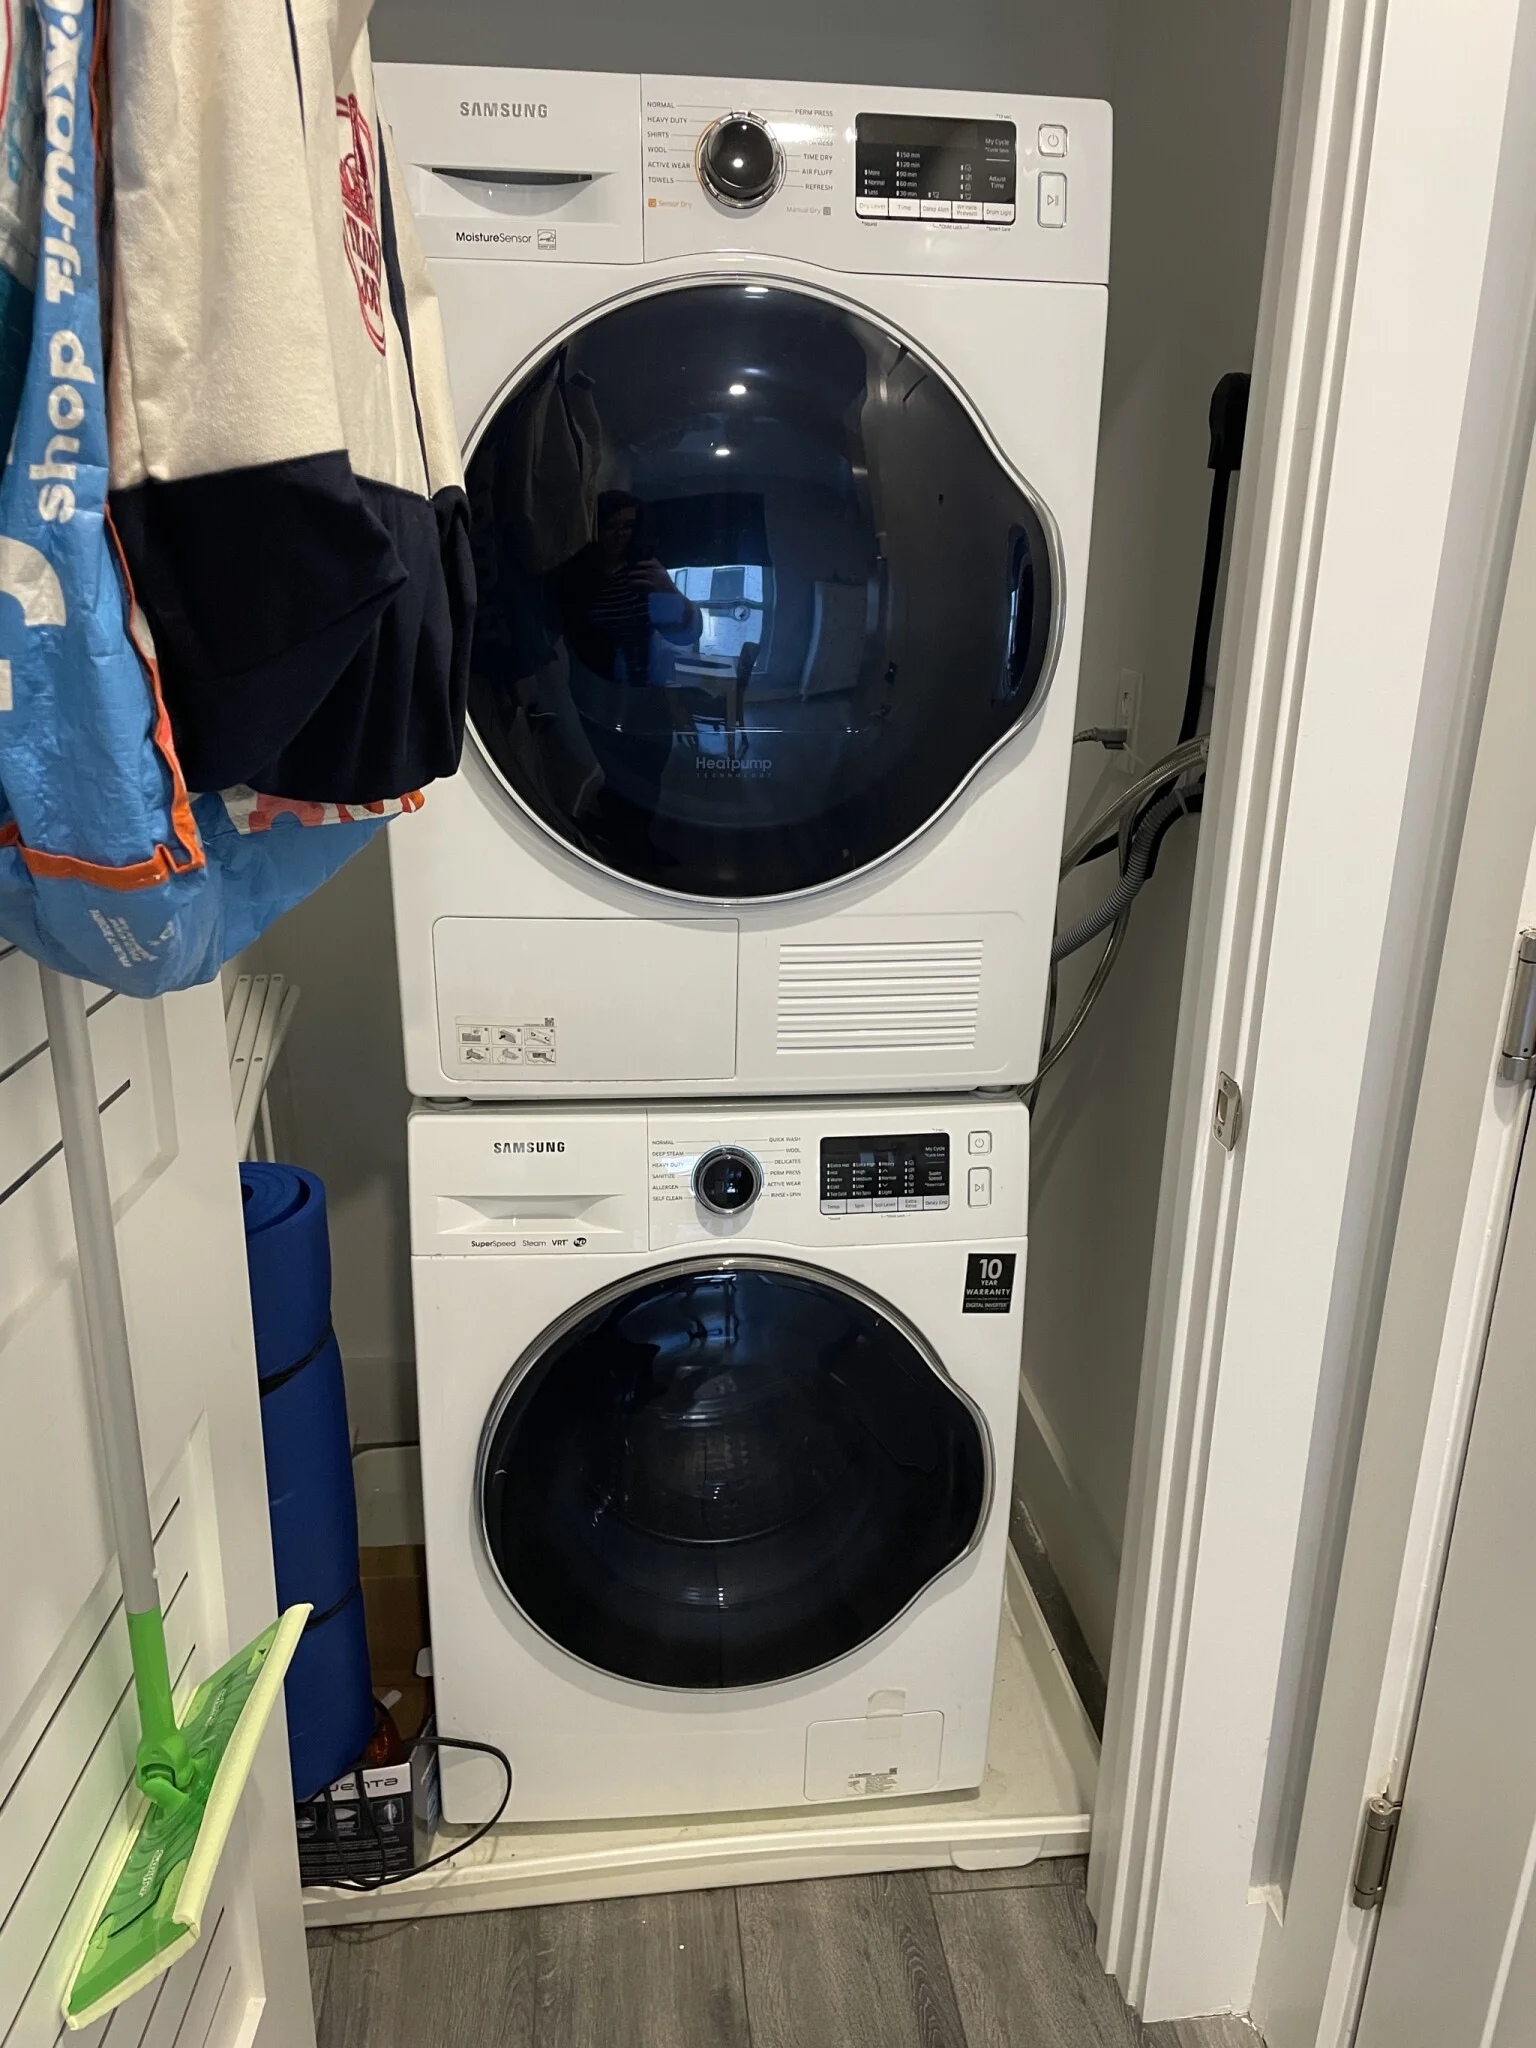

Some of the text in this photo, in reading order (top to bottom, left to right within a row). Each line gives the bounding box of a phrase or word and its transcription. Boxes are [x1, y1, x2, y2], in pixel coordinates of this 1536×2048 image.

[460, 102, 548, 118] SAMSUNG
[680, 200, 692, 209] Dry
[810, 206, 821, 215] Dry
[456, 232, 532, 243] MoistureSensor
[28, 329, 96, 524] shop
[696, 757, 772, 771] Heatpump
[494, 1142, 565, 1153] SAMSUNG
[980, 1258, 1002, 1280] 10
